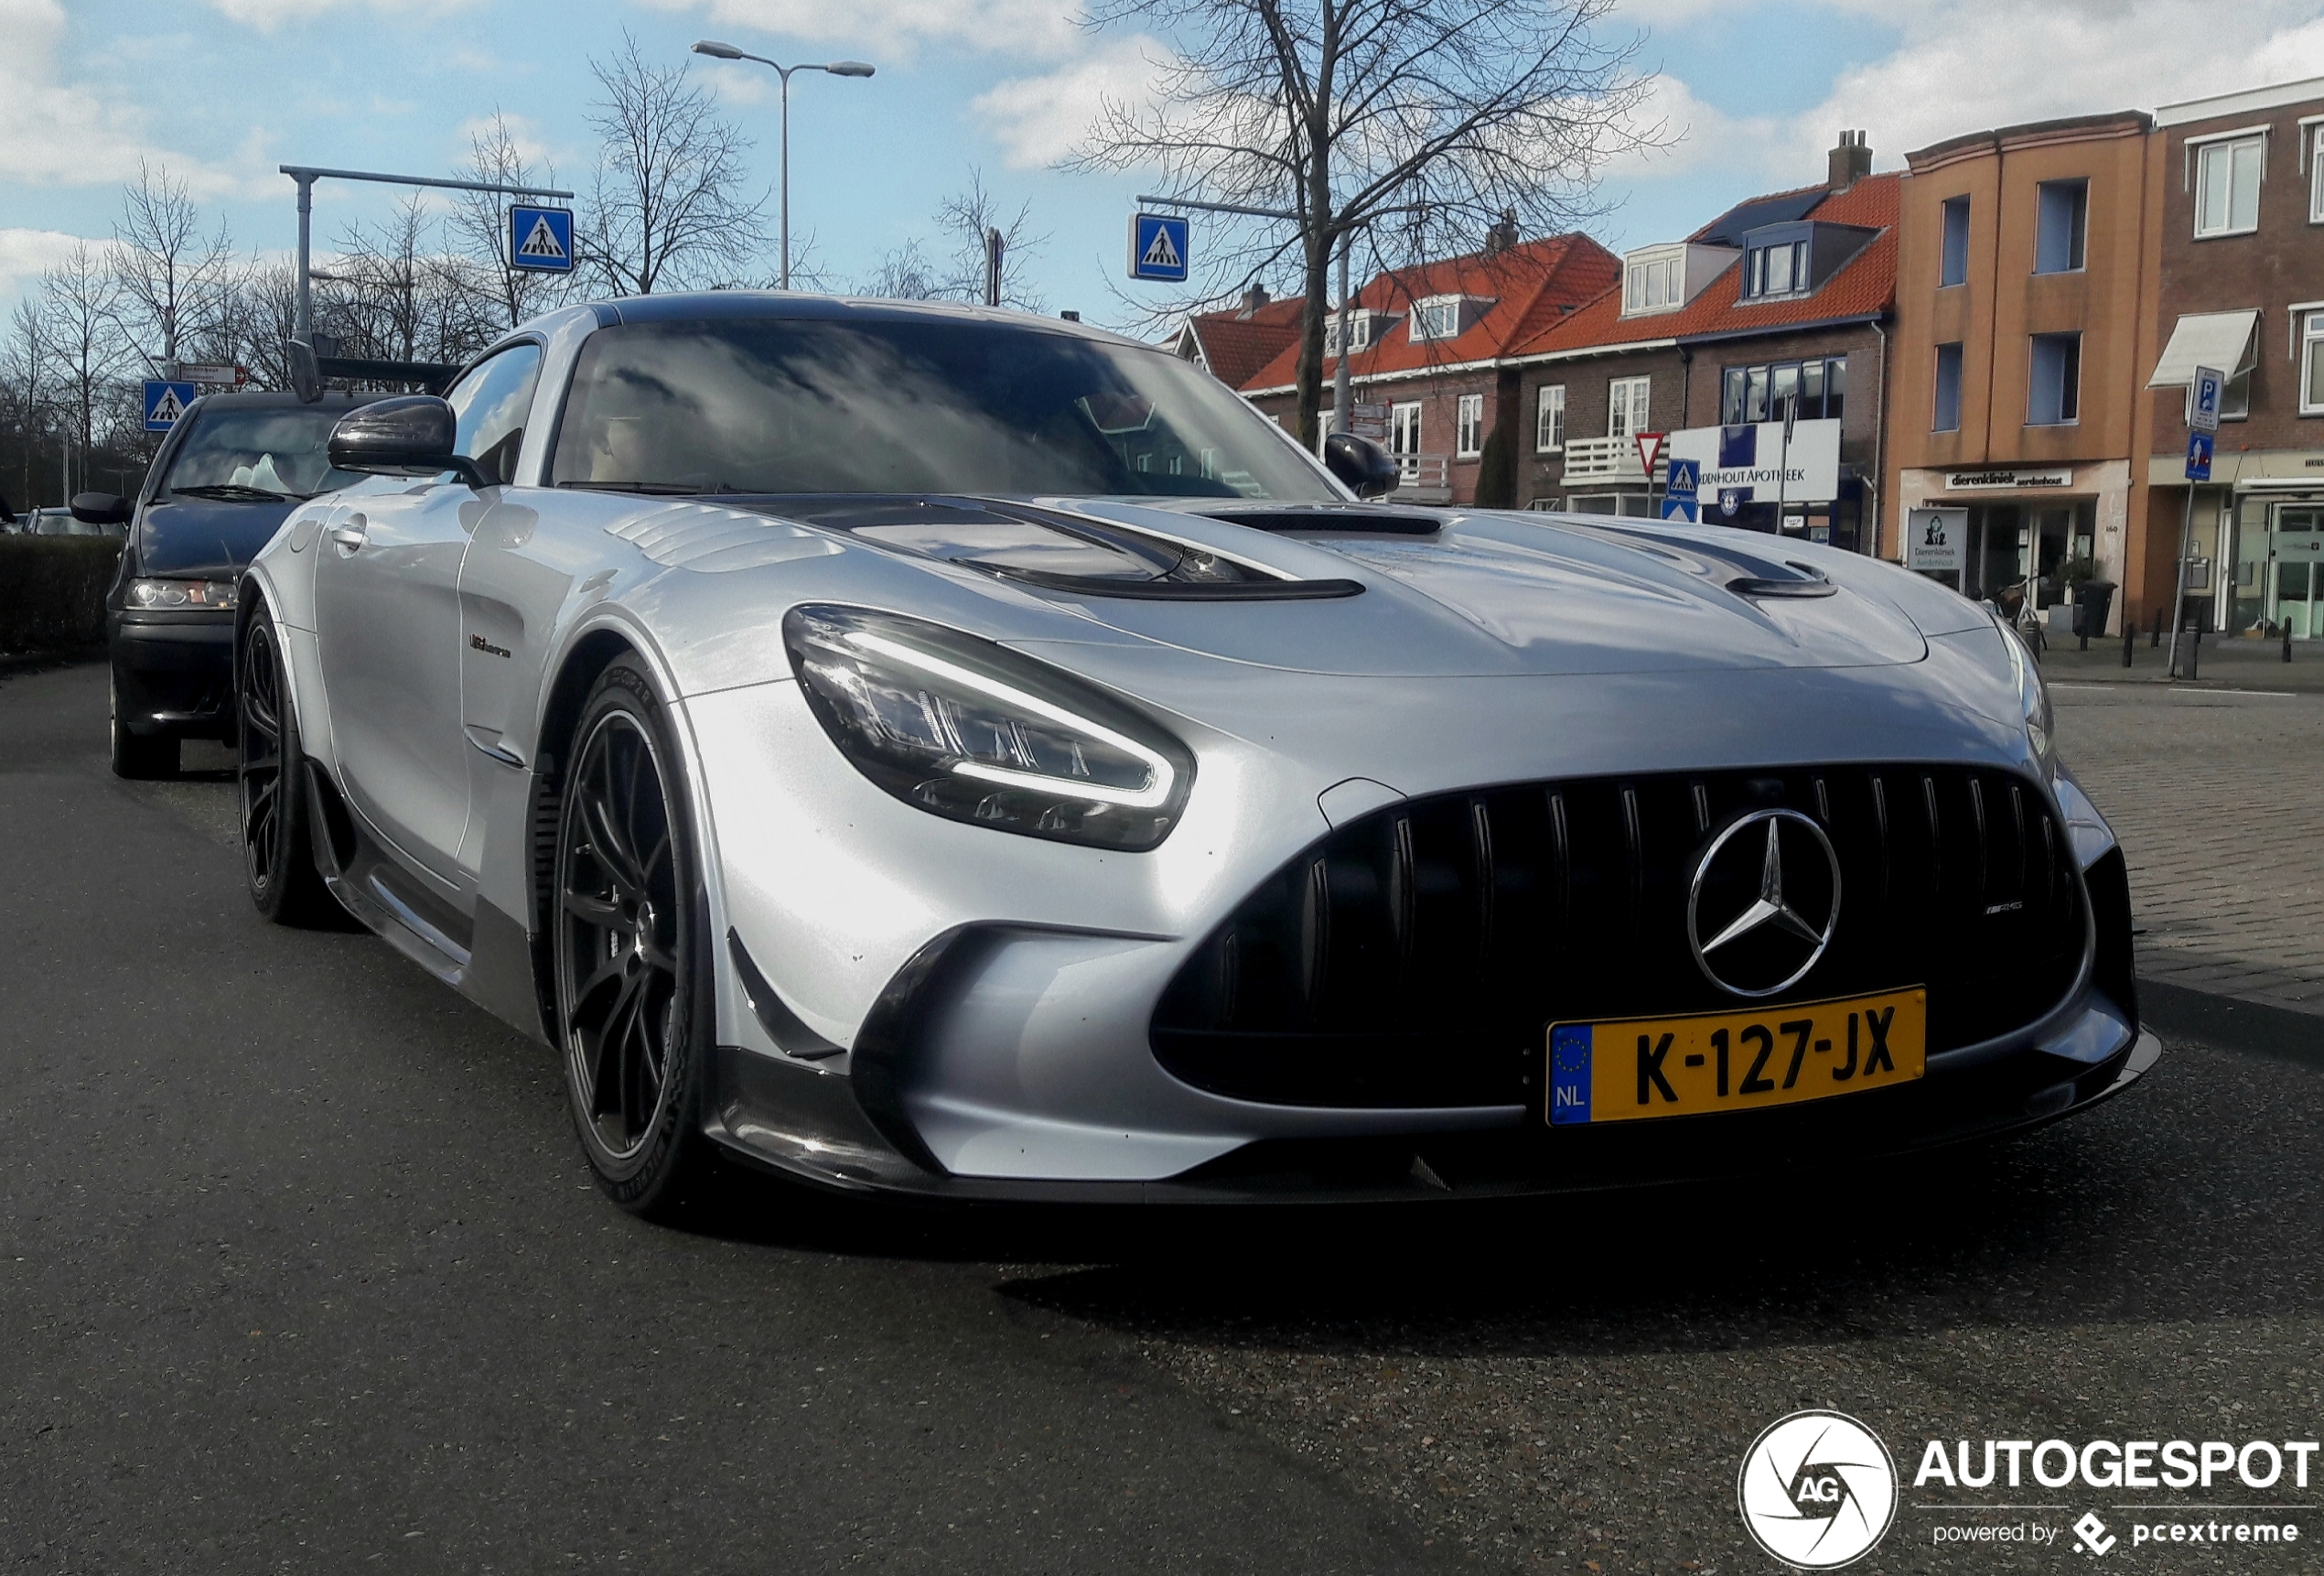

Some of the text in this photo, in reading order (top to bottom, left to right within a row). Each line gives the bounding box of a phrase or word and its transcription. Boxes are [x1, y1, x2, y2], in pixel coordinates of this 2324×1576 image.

[2203, 381, 2213, 397] P
[1747, 469, 1805, 482] APOTHEEK
[1952, 472, 2062, 486] dierenkliniek aerdenhout
[1556, 1007, 1896, 1107] NL K-127-JX
